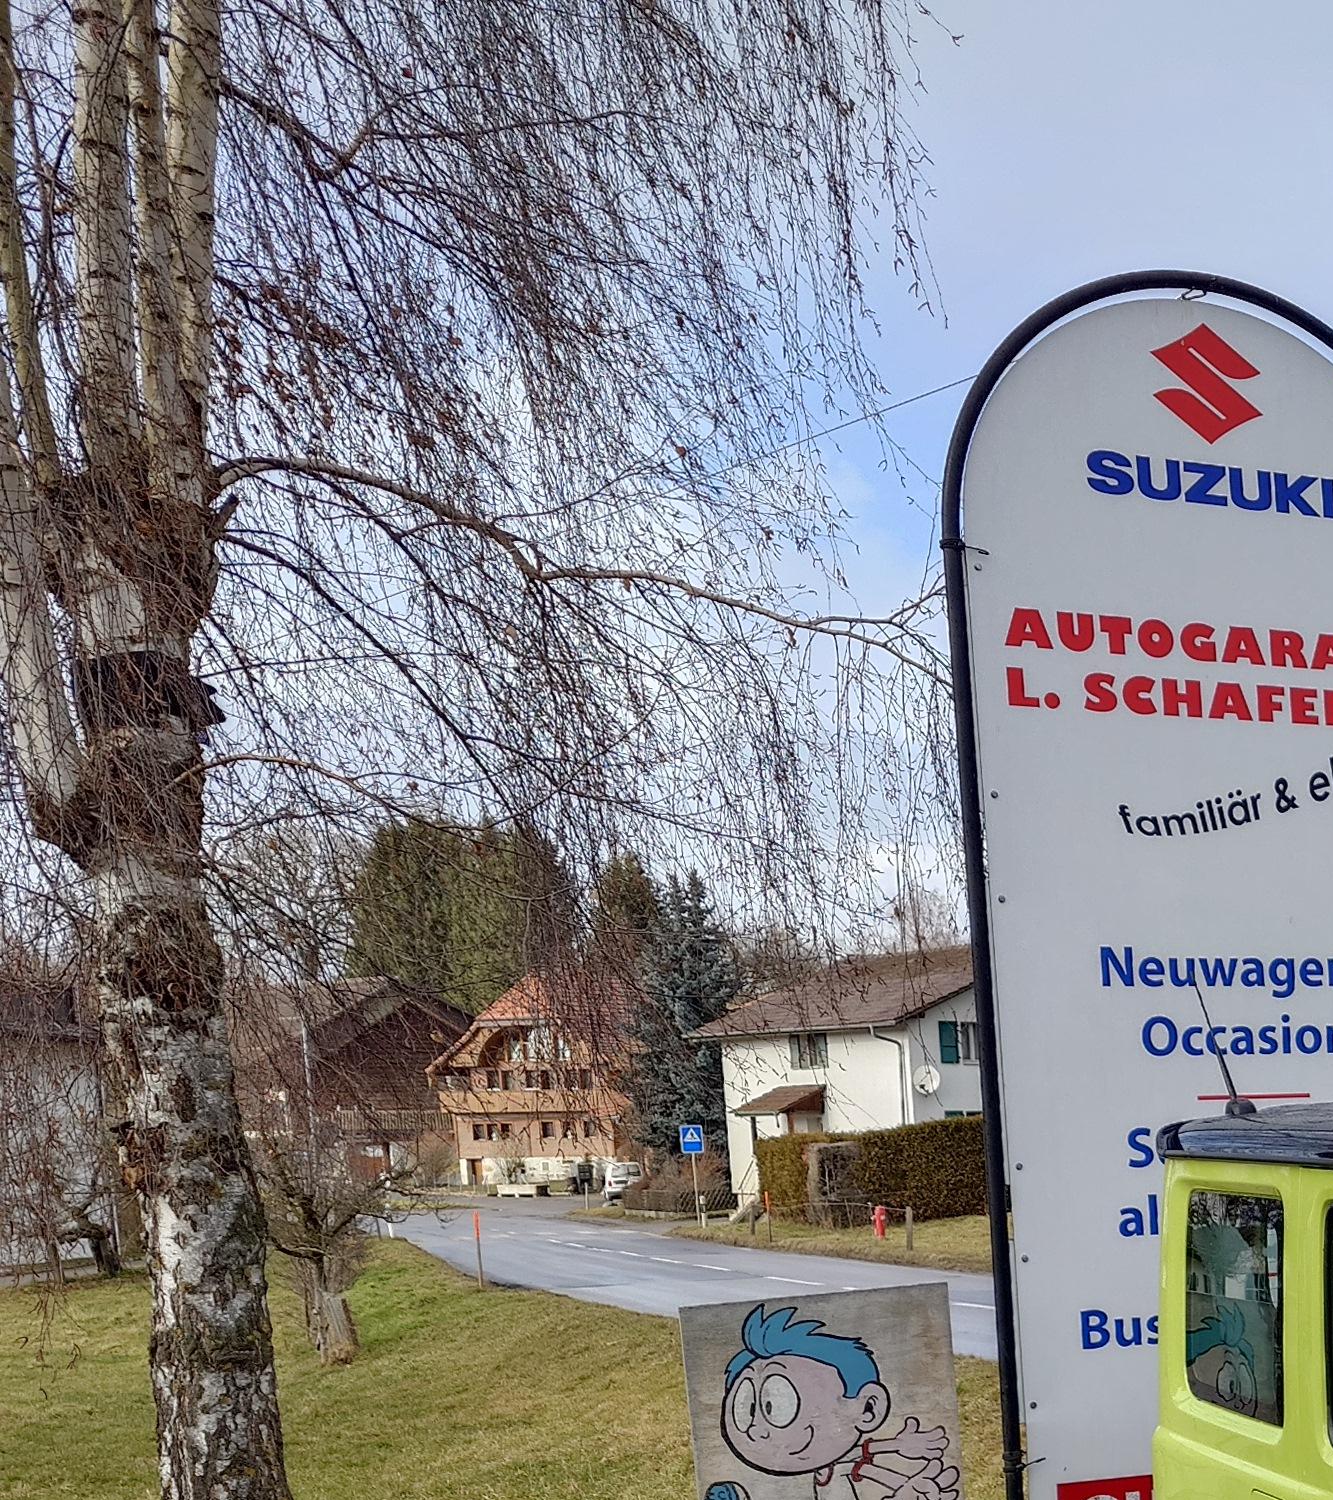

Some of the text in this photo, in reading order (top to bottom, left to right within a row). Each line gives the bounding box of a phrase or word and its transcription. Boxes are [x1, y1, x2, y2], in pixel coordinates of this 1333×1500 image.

[1005, 666, 1061, 710] L.
[1117, 789, 1262, 837] familiär
[1273, 777, 1298, 814] &
